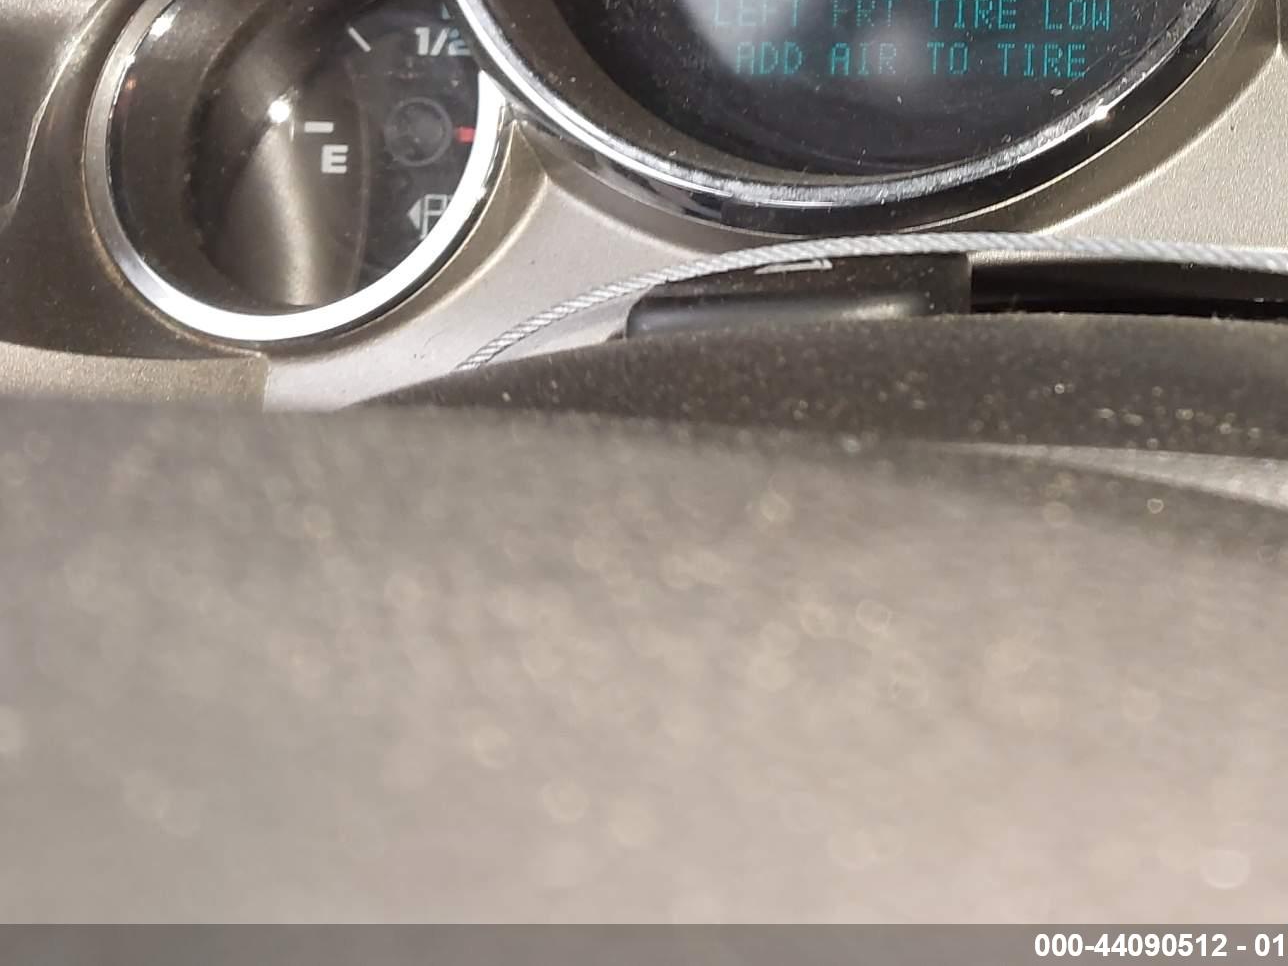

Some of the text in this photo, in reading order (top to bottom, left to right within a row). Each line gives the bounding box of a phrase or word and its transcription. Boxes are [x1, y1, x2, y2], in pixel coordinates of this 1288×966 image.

[736, 42, 1087, 77] ADD AIR TO TIRE
[320, 144, 349, 174] E
